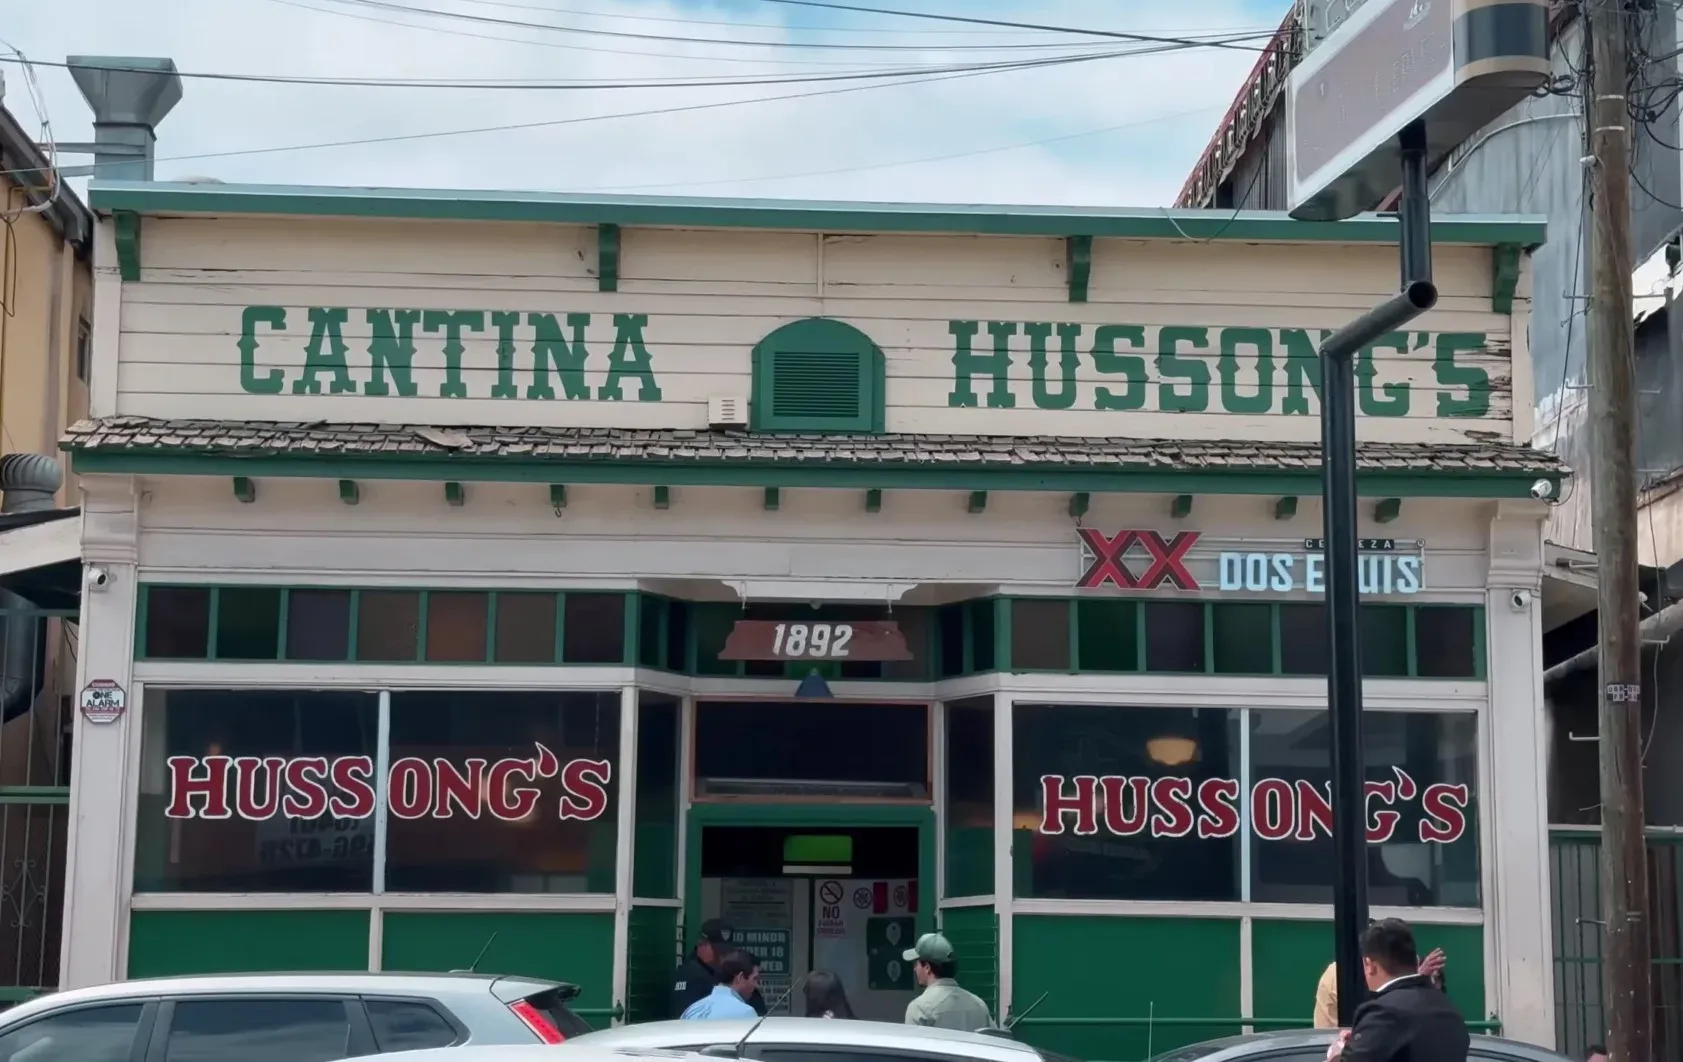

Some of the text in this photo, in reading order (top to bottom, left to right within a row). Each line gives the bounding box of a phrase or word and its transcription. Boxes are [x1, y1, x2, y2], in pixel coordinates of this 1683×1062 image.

[236, 306, 1490, 418] CANTINA HUSSONG'S
[1075, 528, 1202, 591] XX
[1305, 539, 1391, 549] CEEZA
[1219, 551, 1420, 595] DOS EUIS
[772, 623, 853, 657] 1892
[86, 699, 120, 707] ALARM
[92, 691, 112, 699] ONE
[164, 741, 611, 821] HUSSONG'S
[1039, 765, 1468, 843] HUSSONG'S
[822, 906, 840, 919] NO
